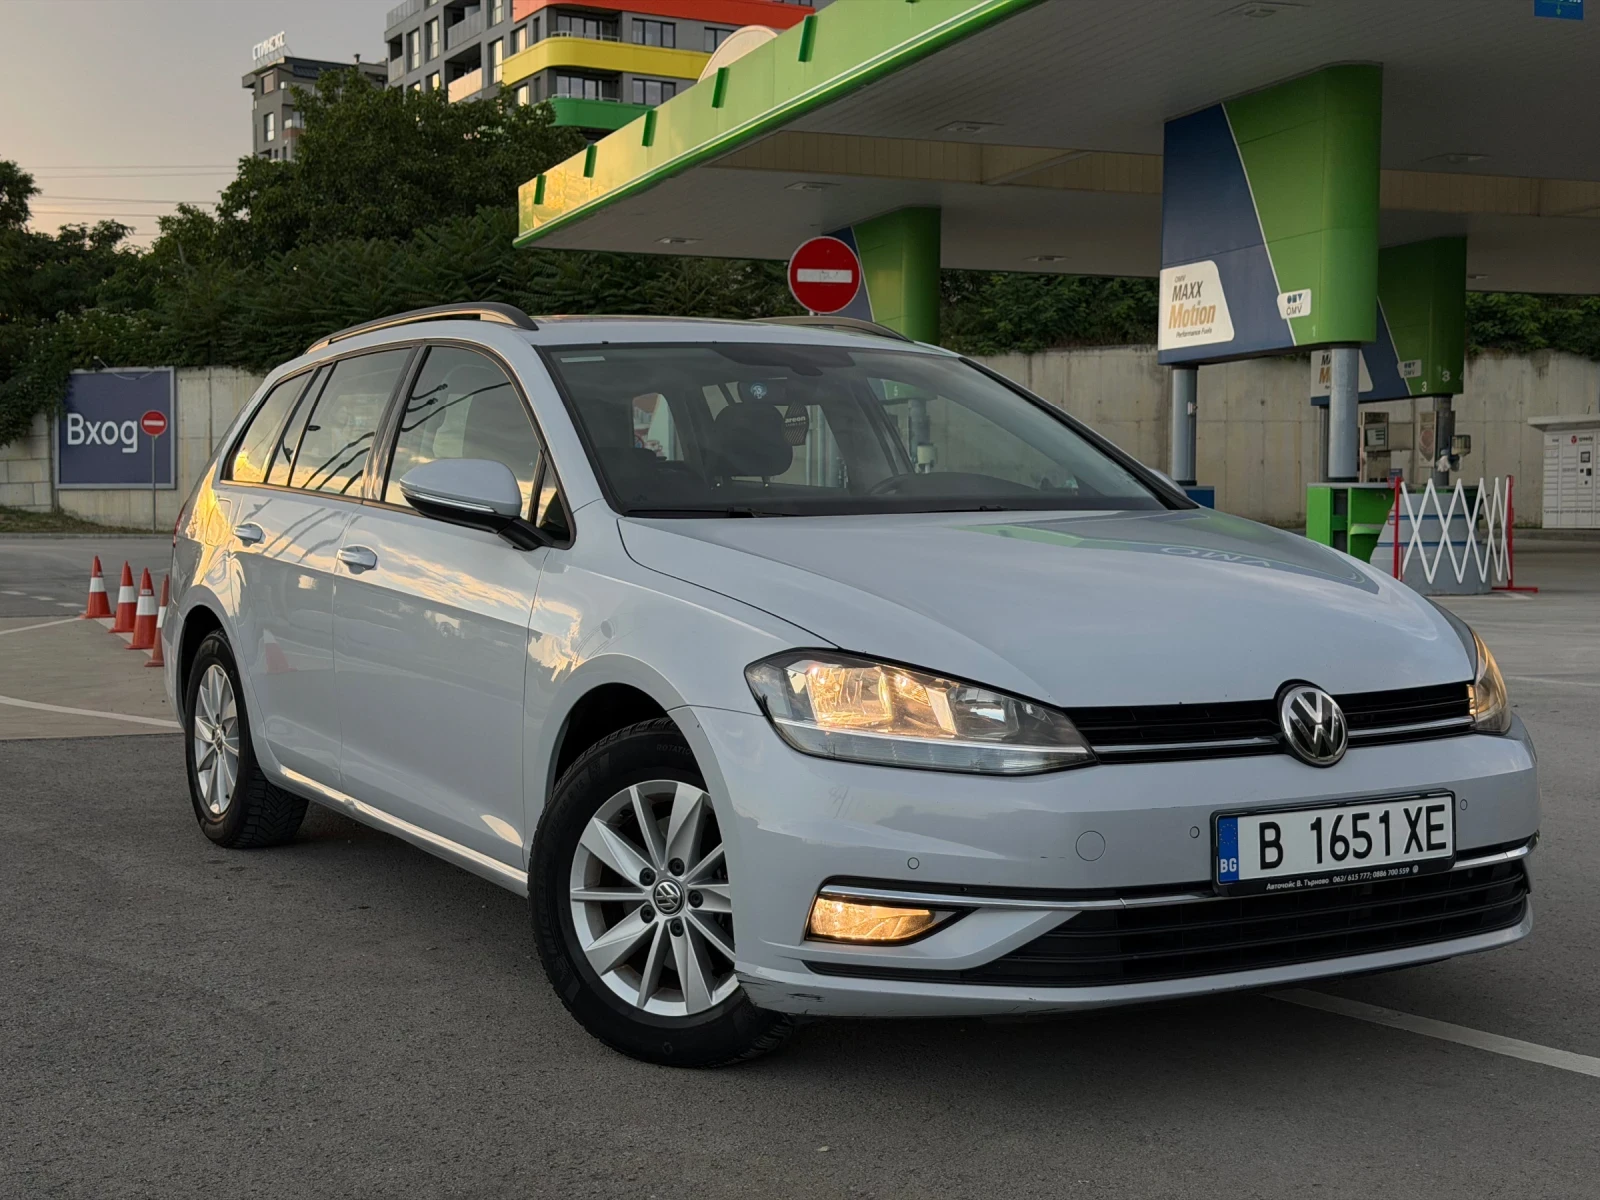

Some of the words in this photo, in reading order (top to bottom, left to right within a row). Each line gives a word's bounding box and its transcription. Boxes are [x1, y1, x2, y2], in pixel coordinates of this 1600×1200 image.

[1172, 280, 1203, 302] MAXX
[1168, 300, 1216, 329] Motion
[1286, 305, 1303, 315] OMV
[1176, 329, 1200, 338] Performance
[1201, 327, 1212, 335] Fuels
[1312, 325, 1316, 337] 1
[1421, 381, 1427, 392] 3
[656, 743, 693, 758] ROTATIO
[1259, 821, 1284, 870] B
[1310, 810, 1391, 864] 1651
[1220, 858, 1238, 873] BG
